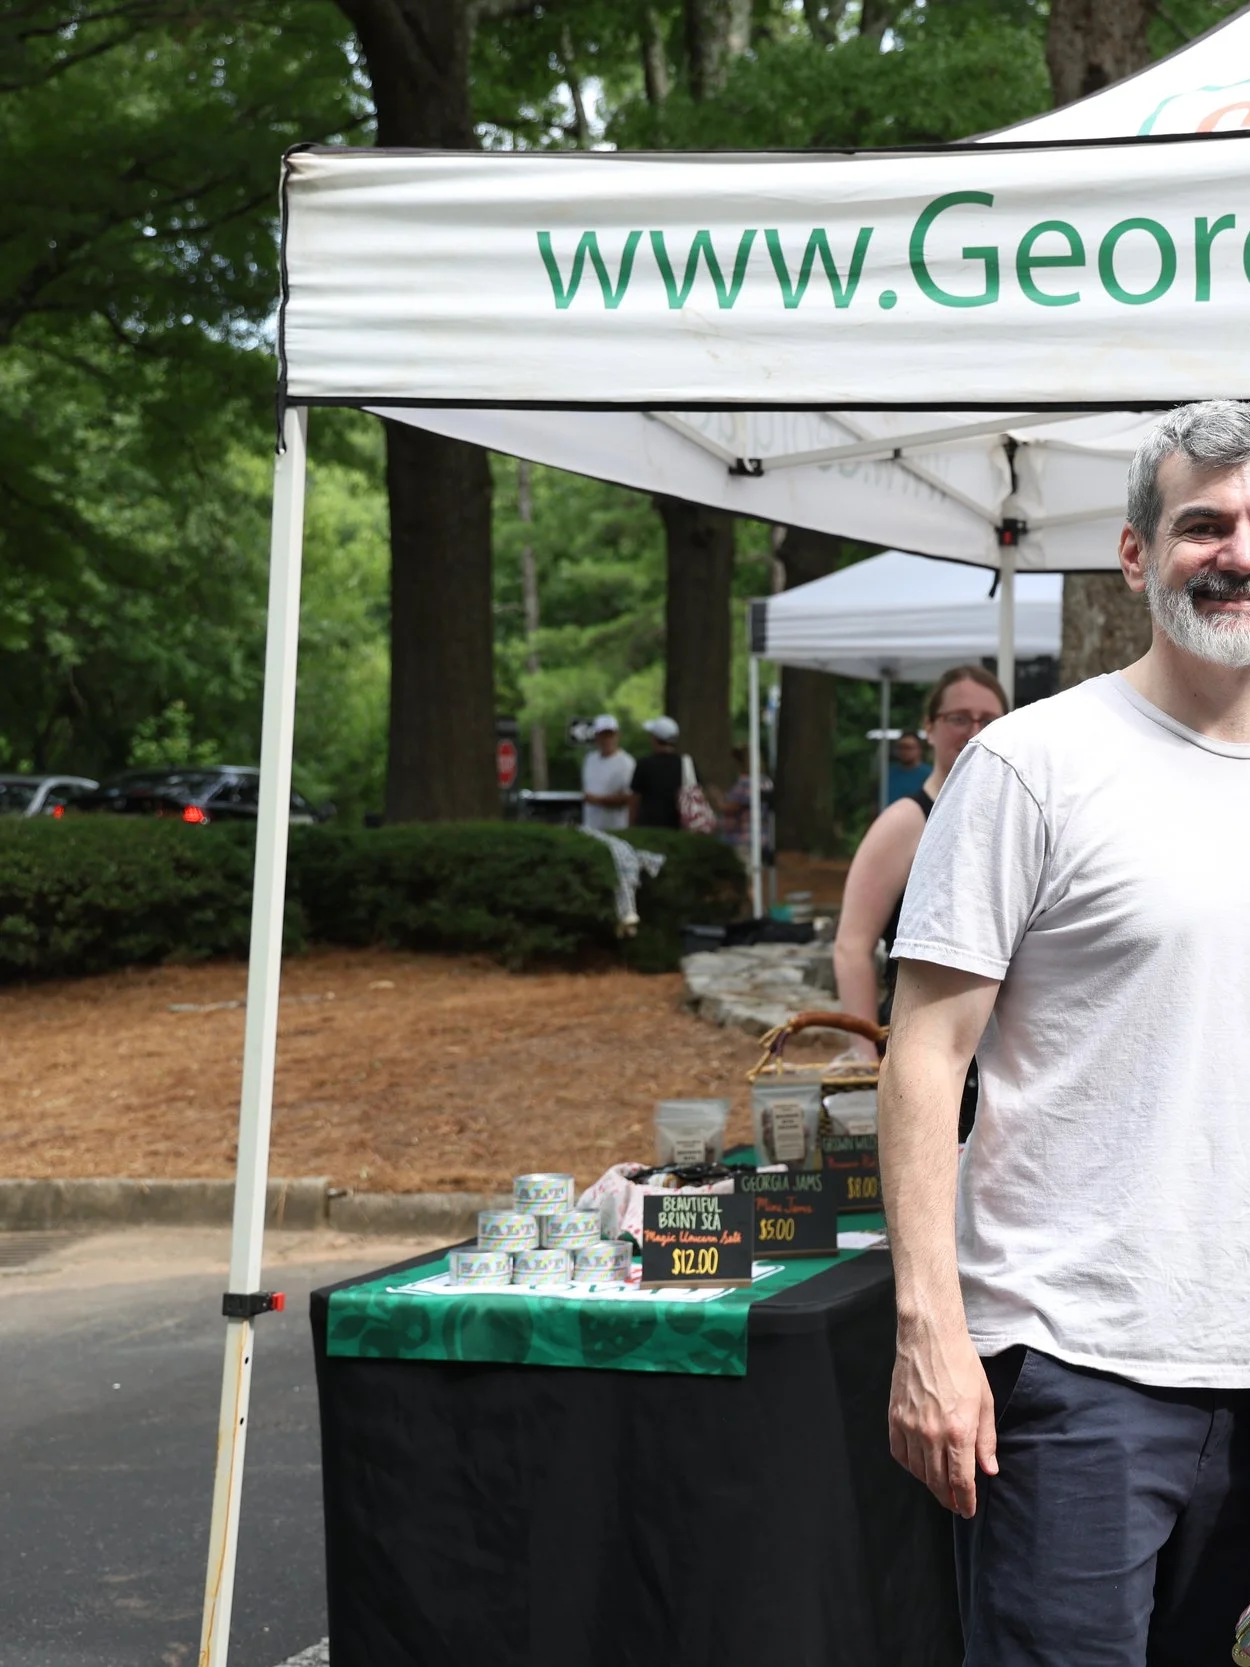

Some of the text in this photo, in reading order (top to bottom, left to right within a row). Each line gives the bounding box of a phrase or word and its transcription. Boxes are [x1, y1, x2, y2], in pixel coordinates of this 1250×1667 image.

[741, 1174, 823, 1192] GEORGIA JAMS
[518, 1187, 564, 1199] ALT
[662, 1196, 723, 1213] BEAUTIFUL
[658, 1212, 722, 1231] BRINY SEA
[759, 1218, 795, 1241] $5.00
[643, 1229, 742, 1247] Magic Unicorn Salt
[514, 1258, 564, 1271] ALT
[577, 1254, 625, 1269] ALT
[671, 1246, 719, 1276] $12.00
